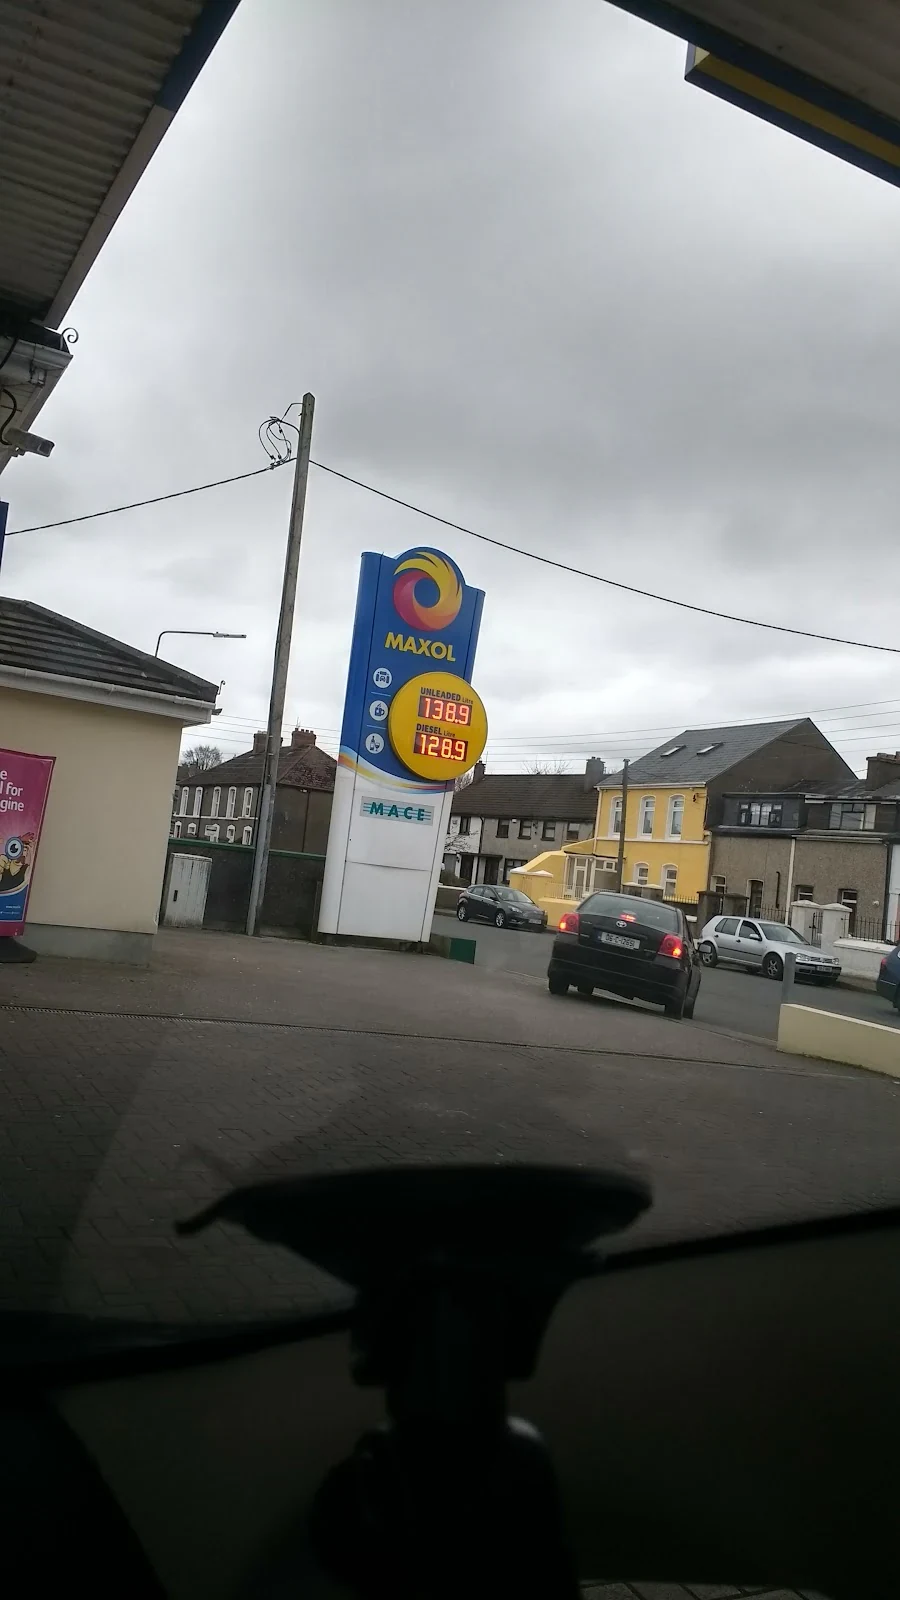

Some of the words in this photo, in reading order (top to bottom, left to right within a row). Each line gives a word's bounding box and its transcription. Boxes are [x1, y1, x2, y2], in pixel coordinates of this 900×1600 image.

[385, 632, 456, 662] MAXOL
[421, 687, 461, 701] UNLEADED
[425, 698, 469, 725] 138.9
[416, 723, 442, 735] DIESEL
[444, 730, 456, 738] Litre
[421, 734, 466, 761] 128.9
[6, 781, 23, 796] for
[369, 801, 425, 821] MACE
